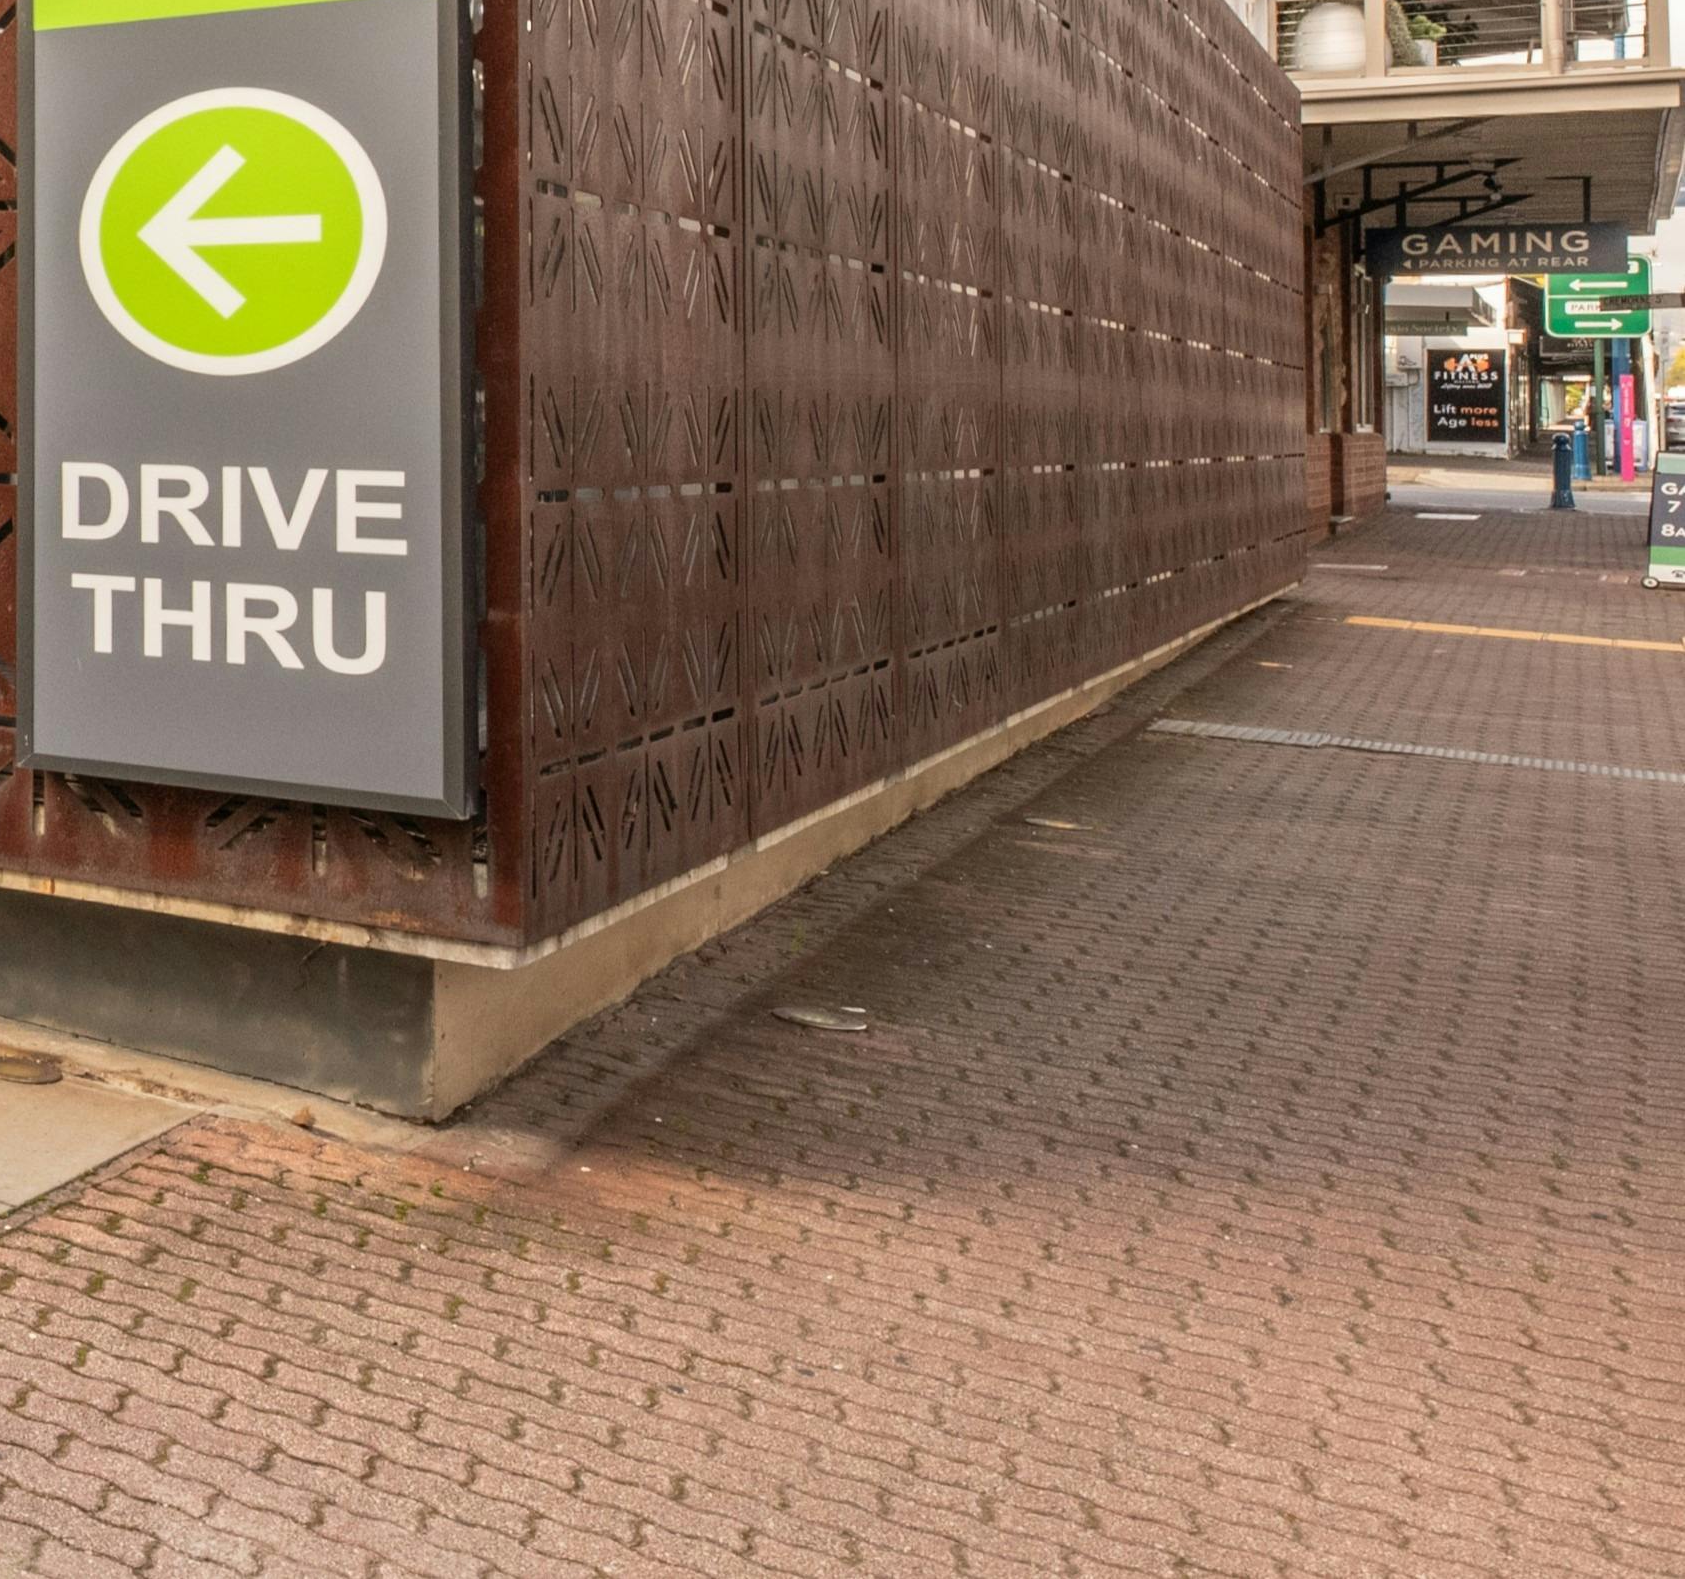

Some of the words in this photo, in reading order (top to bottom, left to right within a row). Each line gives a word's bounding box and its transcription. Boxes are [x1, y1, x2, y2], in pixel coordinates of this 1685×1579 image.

[1402, 230, 1590, 255] GAMING
[1418, 259, 1500, 270] PARKING
[1508, 258, 1530, 268] AT
[1537, 256, 1589, 267] REAR
[1434, 371, 1498, 381] FITNESS
[1433, 404, 1457, 414] Lift
[1460, 406, 1497, 415] more
[1437, 417, 1467, 428] Age
[1471, 417, 1499, 427] less
[60, 461, 408, 556] DRIVE
[1667, 500, 1681, 514] 7
[71, 573, 388, 675] THRU
